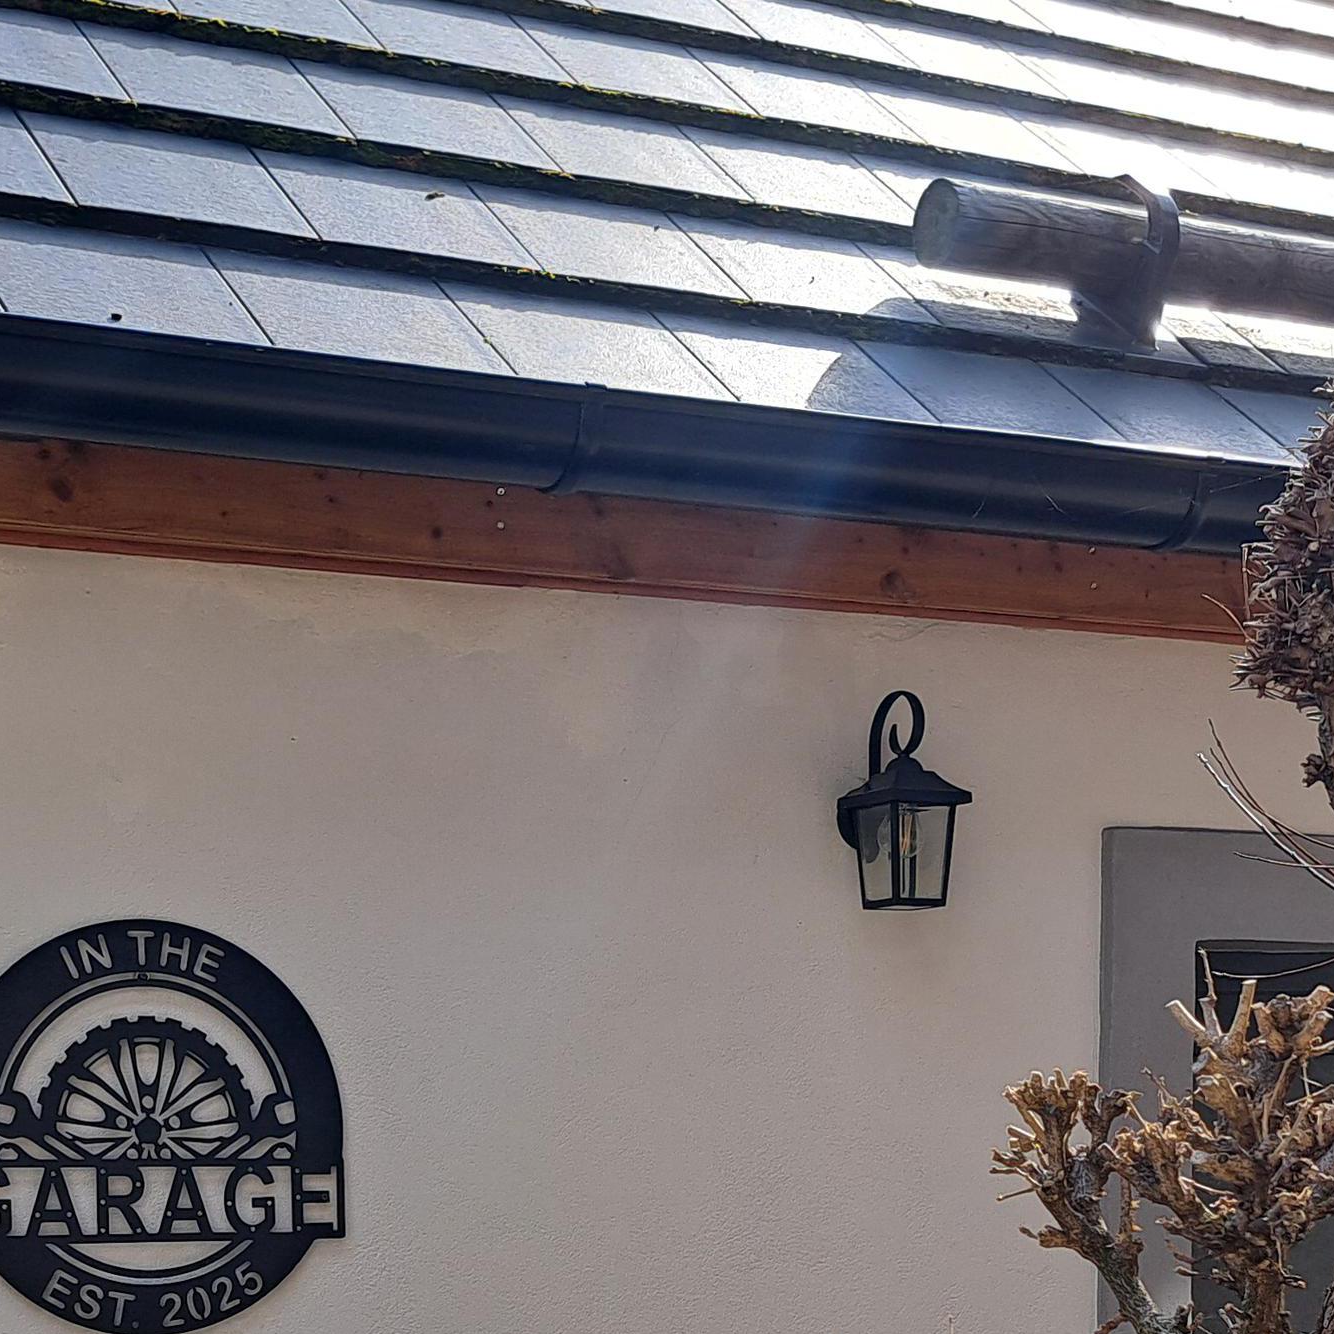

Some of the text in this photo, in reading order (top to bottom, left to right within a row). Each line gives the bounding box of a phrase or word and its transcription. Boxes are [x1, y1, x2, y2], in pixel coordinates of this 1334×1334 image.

[59, 930, 225, 983] IN THE
[41, 1260, 264, 1329] EST. 2025
